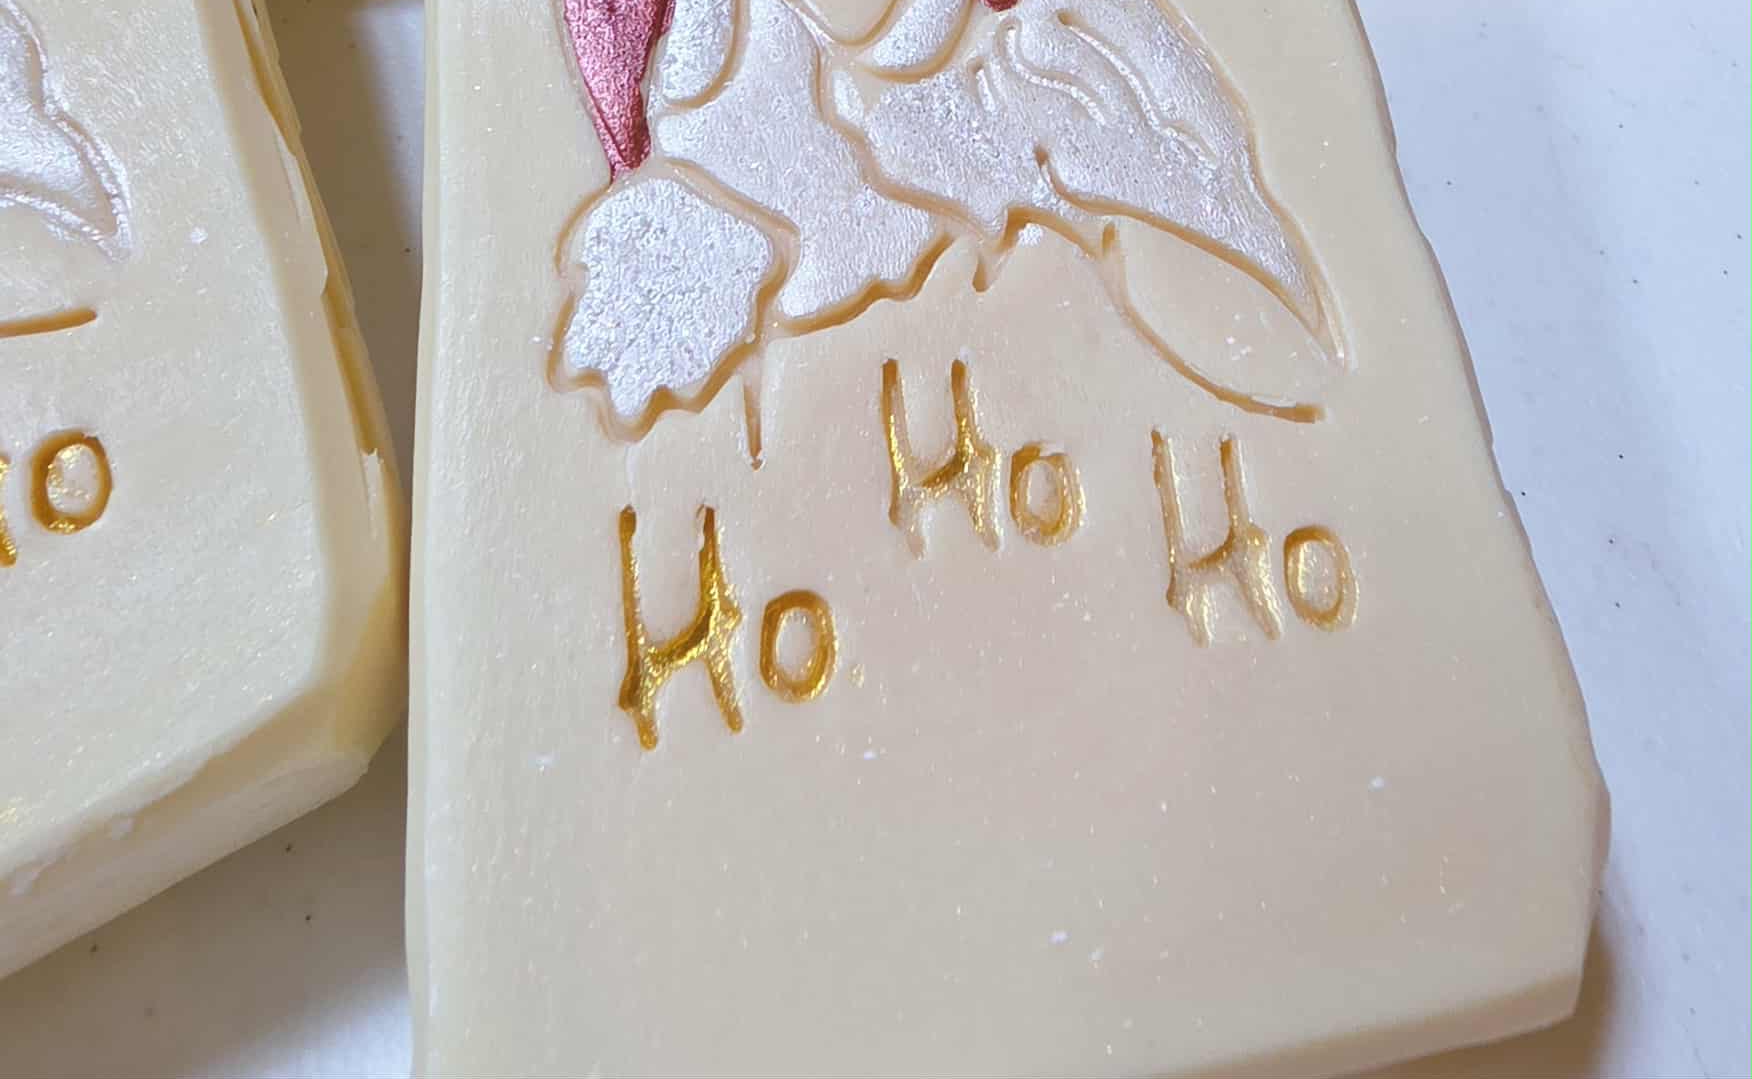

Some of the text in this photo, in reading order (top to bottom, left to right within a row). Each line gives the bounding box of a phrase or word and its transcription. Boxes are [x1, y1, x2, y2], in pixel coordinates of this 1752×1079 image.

[618, 357, 1360, 752] Ho Ho Ho
